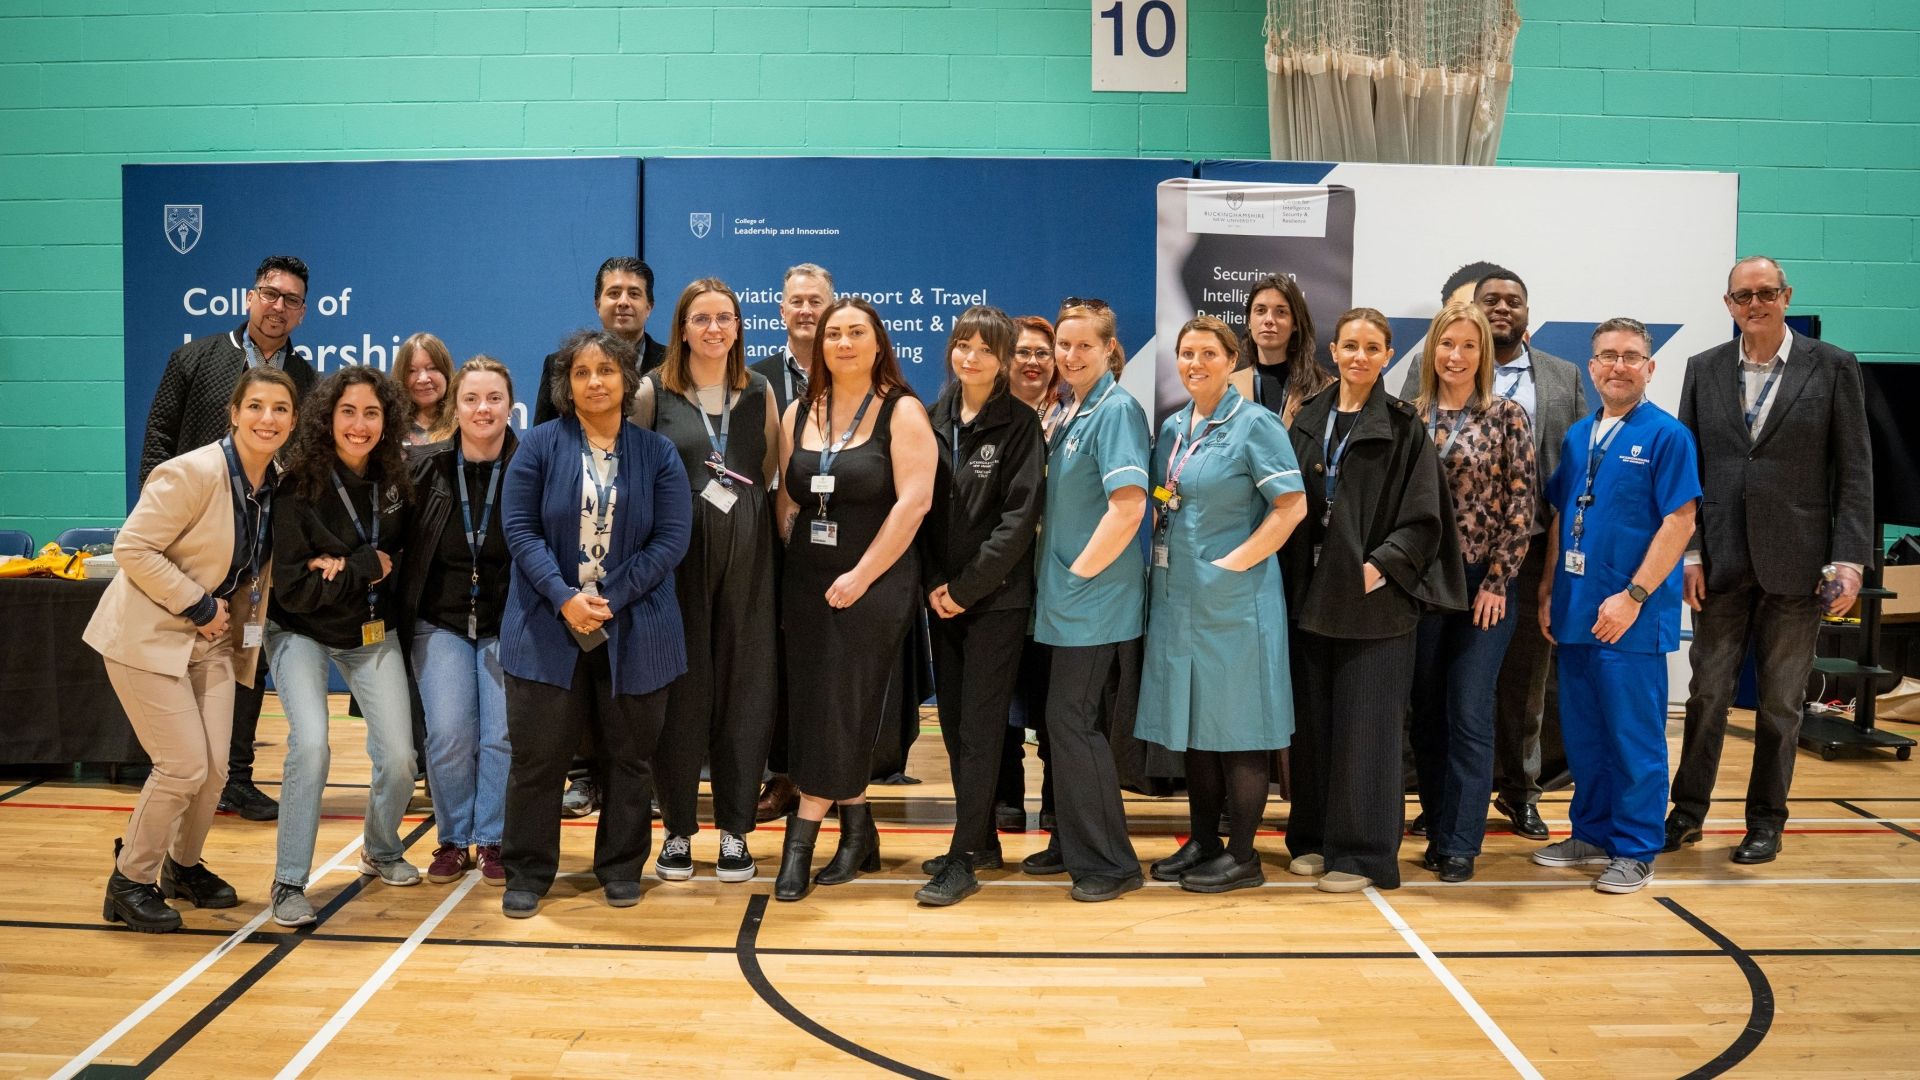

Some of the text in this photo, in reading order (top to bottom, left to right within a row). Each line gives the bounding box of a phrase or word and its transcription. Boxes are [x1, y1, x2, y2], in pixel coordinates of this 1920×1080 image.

[1101, 0, 1176, 58] 10
[1204, 211, 1265, 219] BUCKINGHAMSHIRE
[734, 227, 840, 237] Leadership and Innovation
[317, 287, 352, 316] of
[909, 288, 924, 305] &
[931, 287, 987, 306] Travel
[930, 315, 945, 331] &
